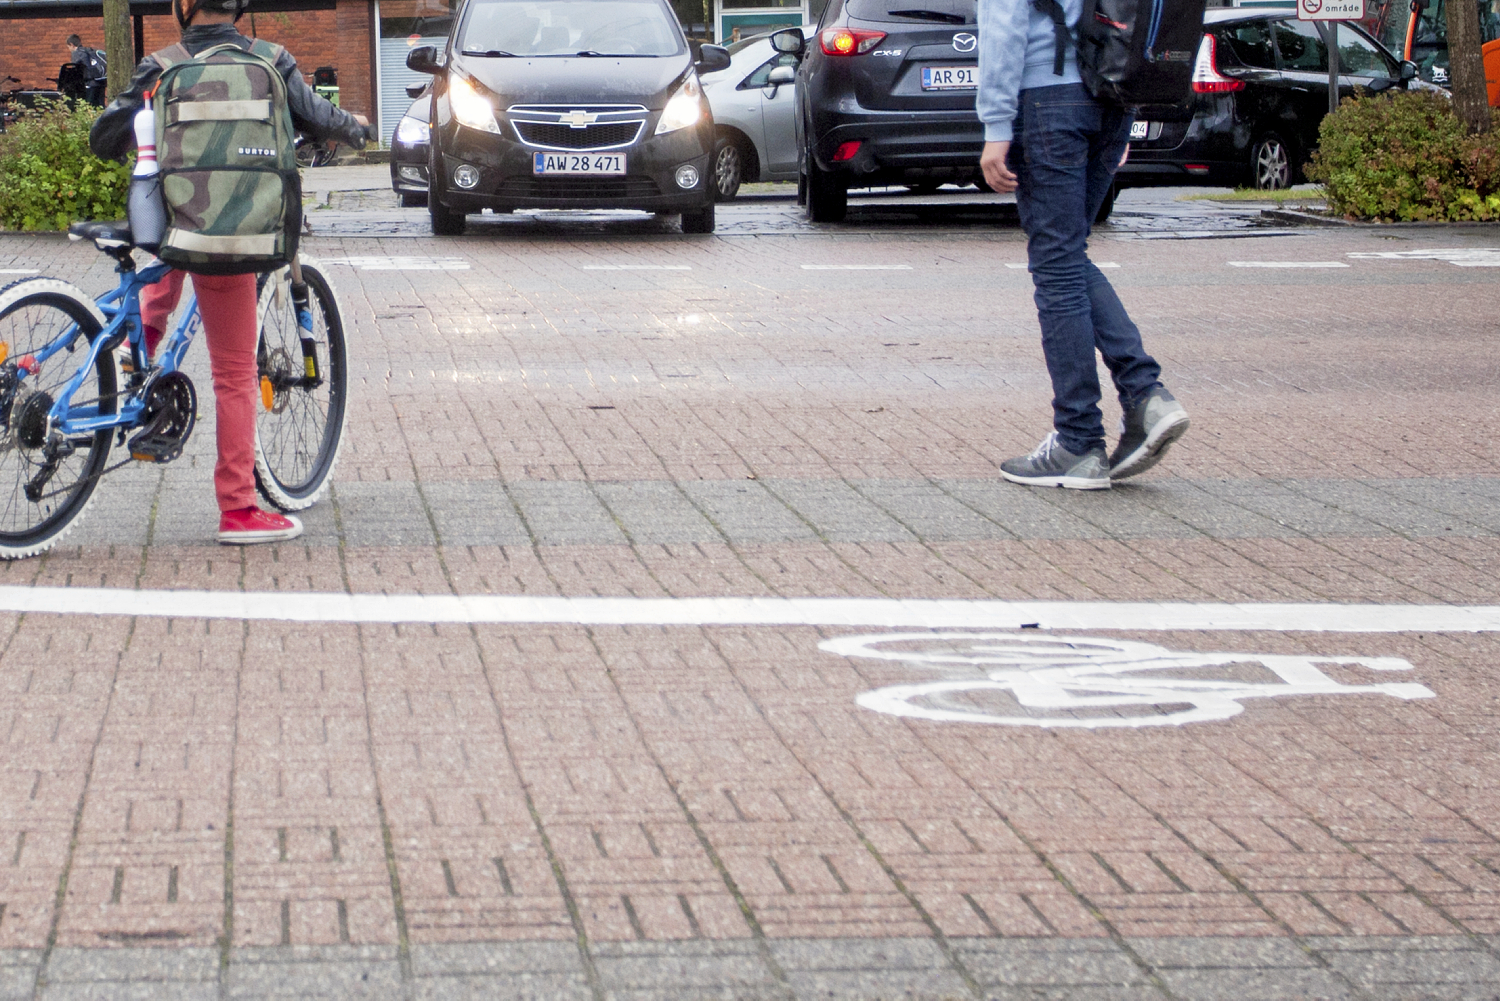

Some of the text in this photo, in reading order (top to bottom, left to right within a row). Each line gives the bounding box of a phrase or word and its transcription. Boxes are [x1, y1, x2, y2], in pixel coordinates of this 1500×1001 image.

[1325, 4, 1360, 12] område
[872, 49, 902, 57] CX-5
[933, 70, 953, 84] AR
[956, 69, 974, 83] 91
[1132, 123, 1145, 134] 04
[238, 147, 276, 156] BURTON
[546, 156, 567, 171] AW
[571, 156, 590, 171] 28
[594, 156, 621, 171] 471
